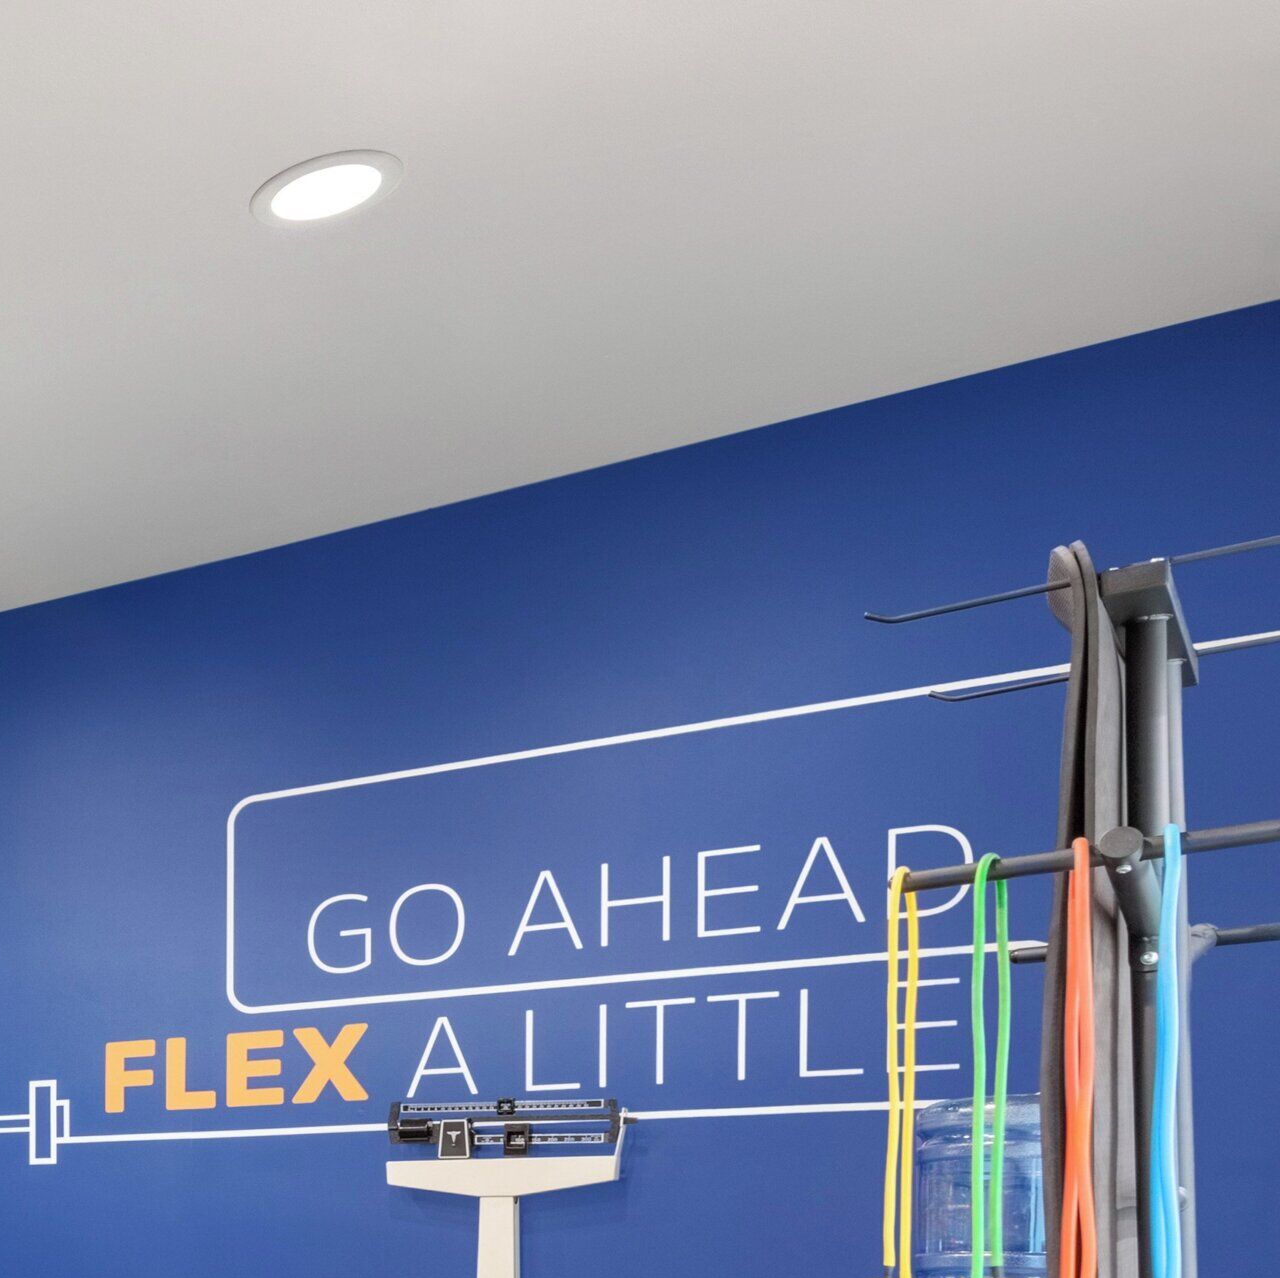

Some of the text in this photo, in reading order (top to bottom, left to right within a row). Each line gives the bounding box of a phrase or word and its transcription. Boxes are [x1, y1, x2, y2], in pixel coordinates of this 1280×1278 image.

[306, 823, 974, 974] GO AHEAD
[104, 976, 961, 1114] FLEX A LITTLE
